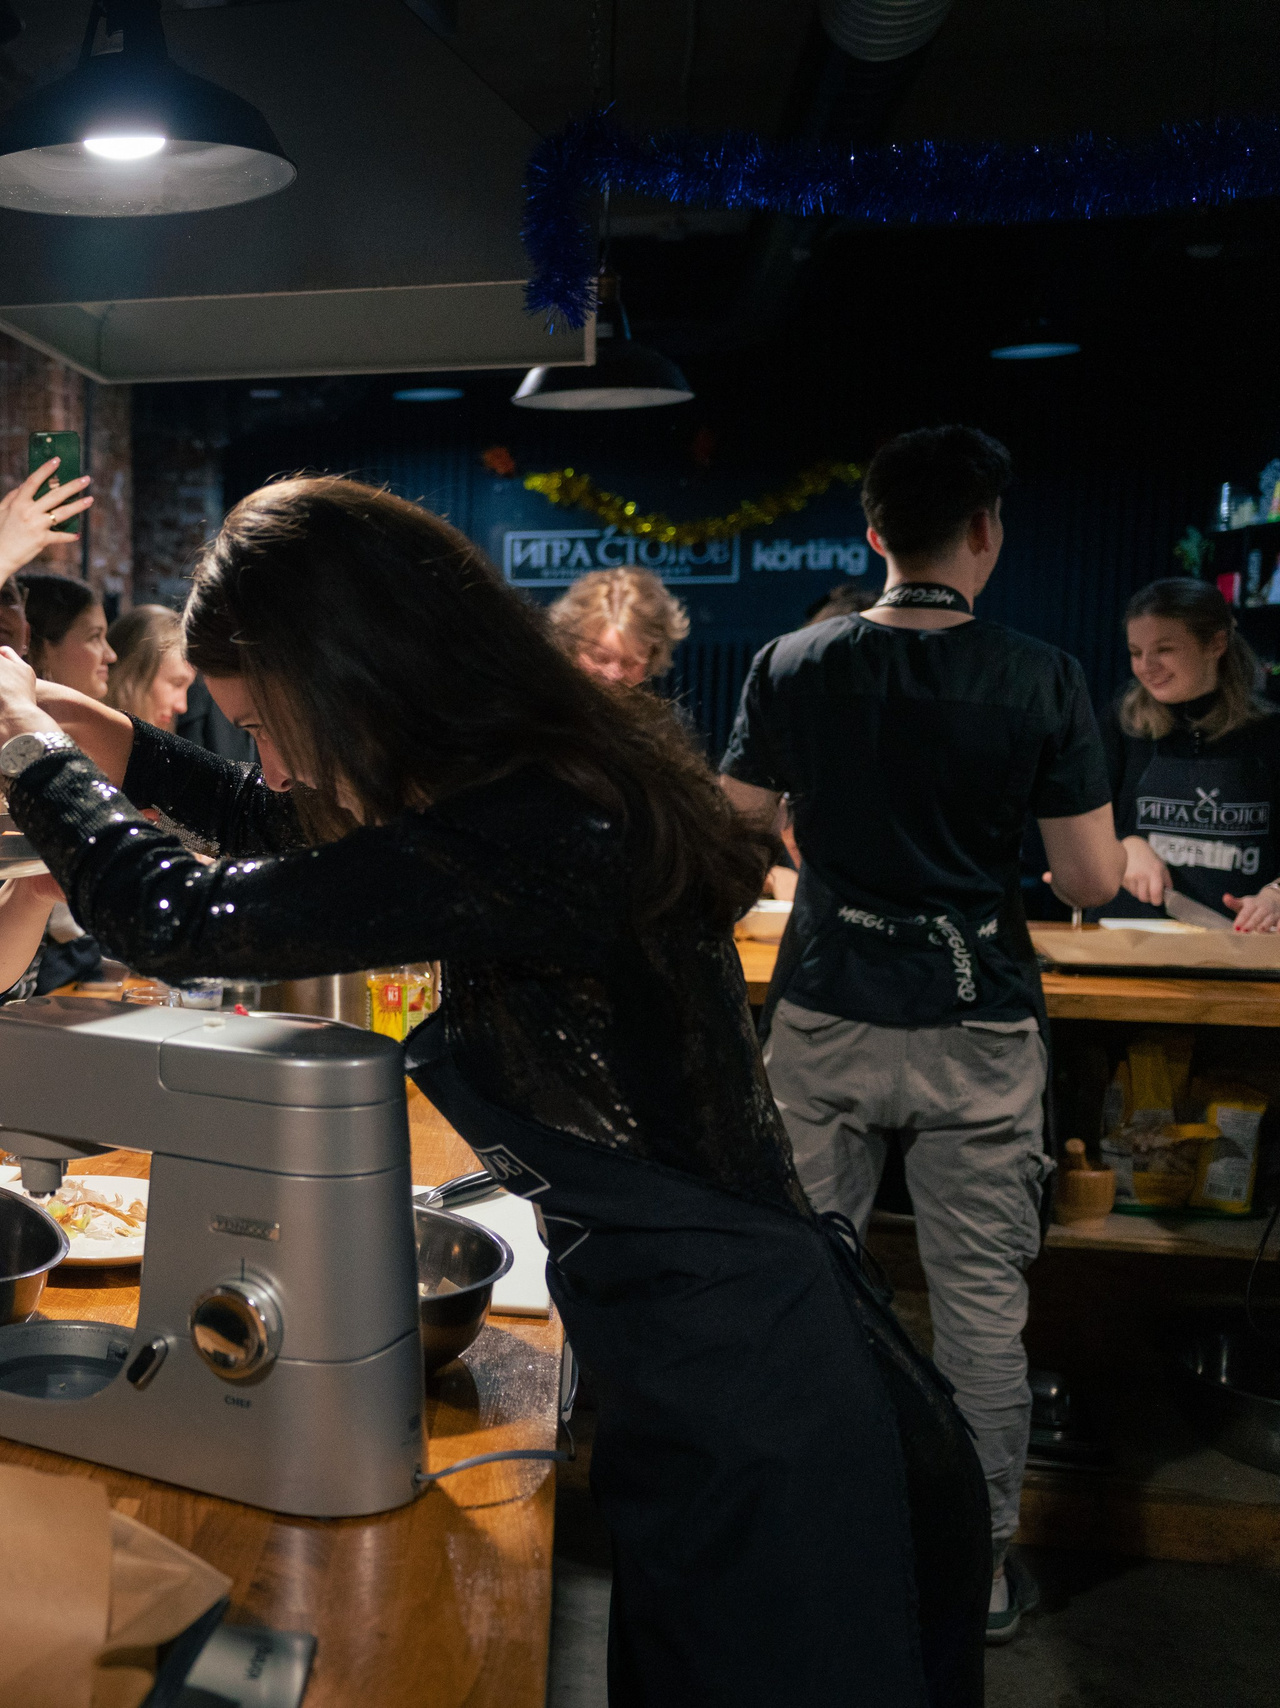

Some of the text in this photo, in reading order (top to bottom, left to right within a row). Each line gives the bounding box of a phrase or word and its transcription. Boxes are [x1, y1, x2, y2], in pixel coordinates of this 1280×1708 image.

[512, 539, 593, 569] ИГРА
[751, 538, 869, 576] körting
[1139, 801, 1190, 822] ИГРА
[223, 1394, 252, 1409] CHEF
